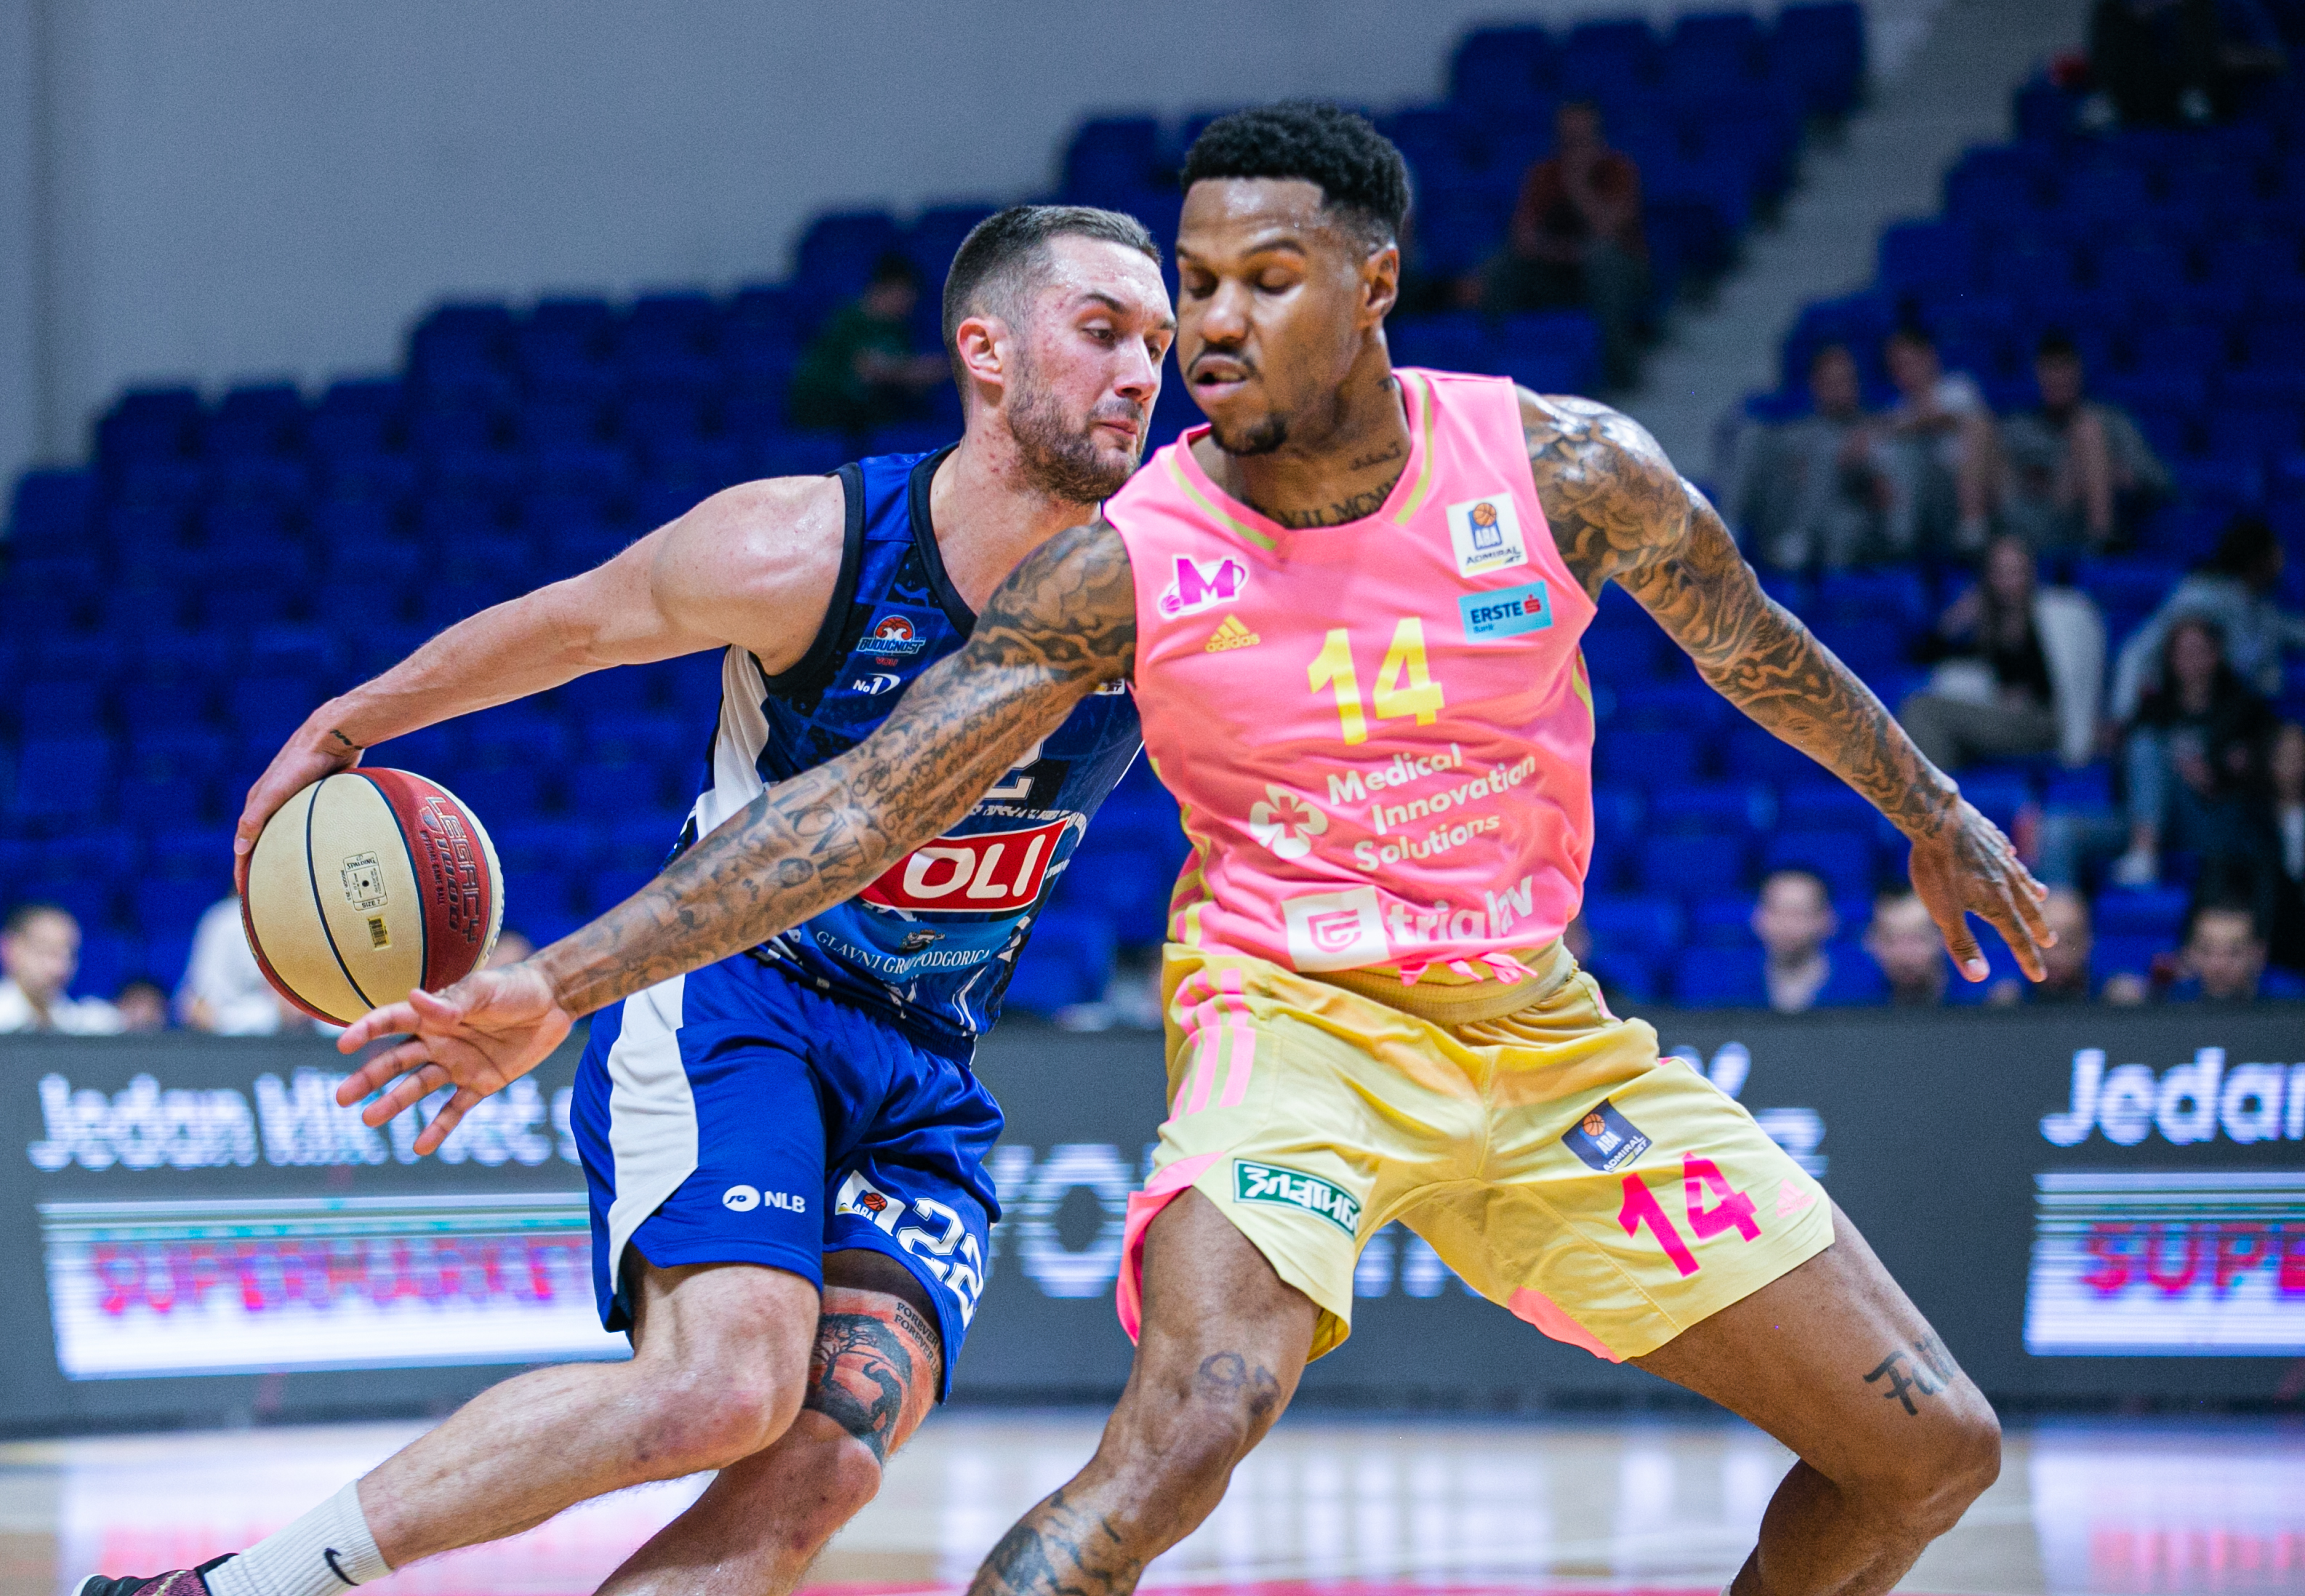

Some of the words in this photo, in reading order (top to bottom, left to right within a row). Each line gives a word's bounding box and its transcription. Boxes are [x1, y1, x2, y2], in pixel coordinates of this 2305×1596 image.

[1471, 601, 1524, 624] ERSTE
[876, 656, 898, 666] VOLI
[1205, 632, 1260, 653] adidas
[1307, 616, 1445, 746] 14
[1327, 743, 1463, 806] Medical
[1371, 754, 1536, 835] Innovation
[346, 857, 377, 870] SPALDING
[1353, 814, 1501, 871] Solutions
[426, 797, 480, 943] LEGACY
[903, 834, 1046, 899] OLI
[361, 900, 376, 908] SIZE
[816, 930, 881, 970] GLAVNI
[1596, 1131, 1622, 1155] ABA
[1603, 1135, 1644, 1172] ADMIRAL
[764, 1190, 805, 1213] NLB
[1617, 1151, 1762, 1279] 14
[896, 1198, 983, 1331] 22
[894, 1314, 933, 1361] FOREVER
[897, 1302, 939, 1347] FOREVER
